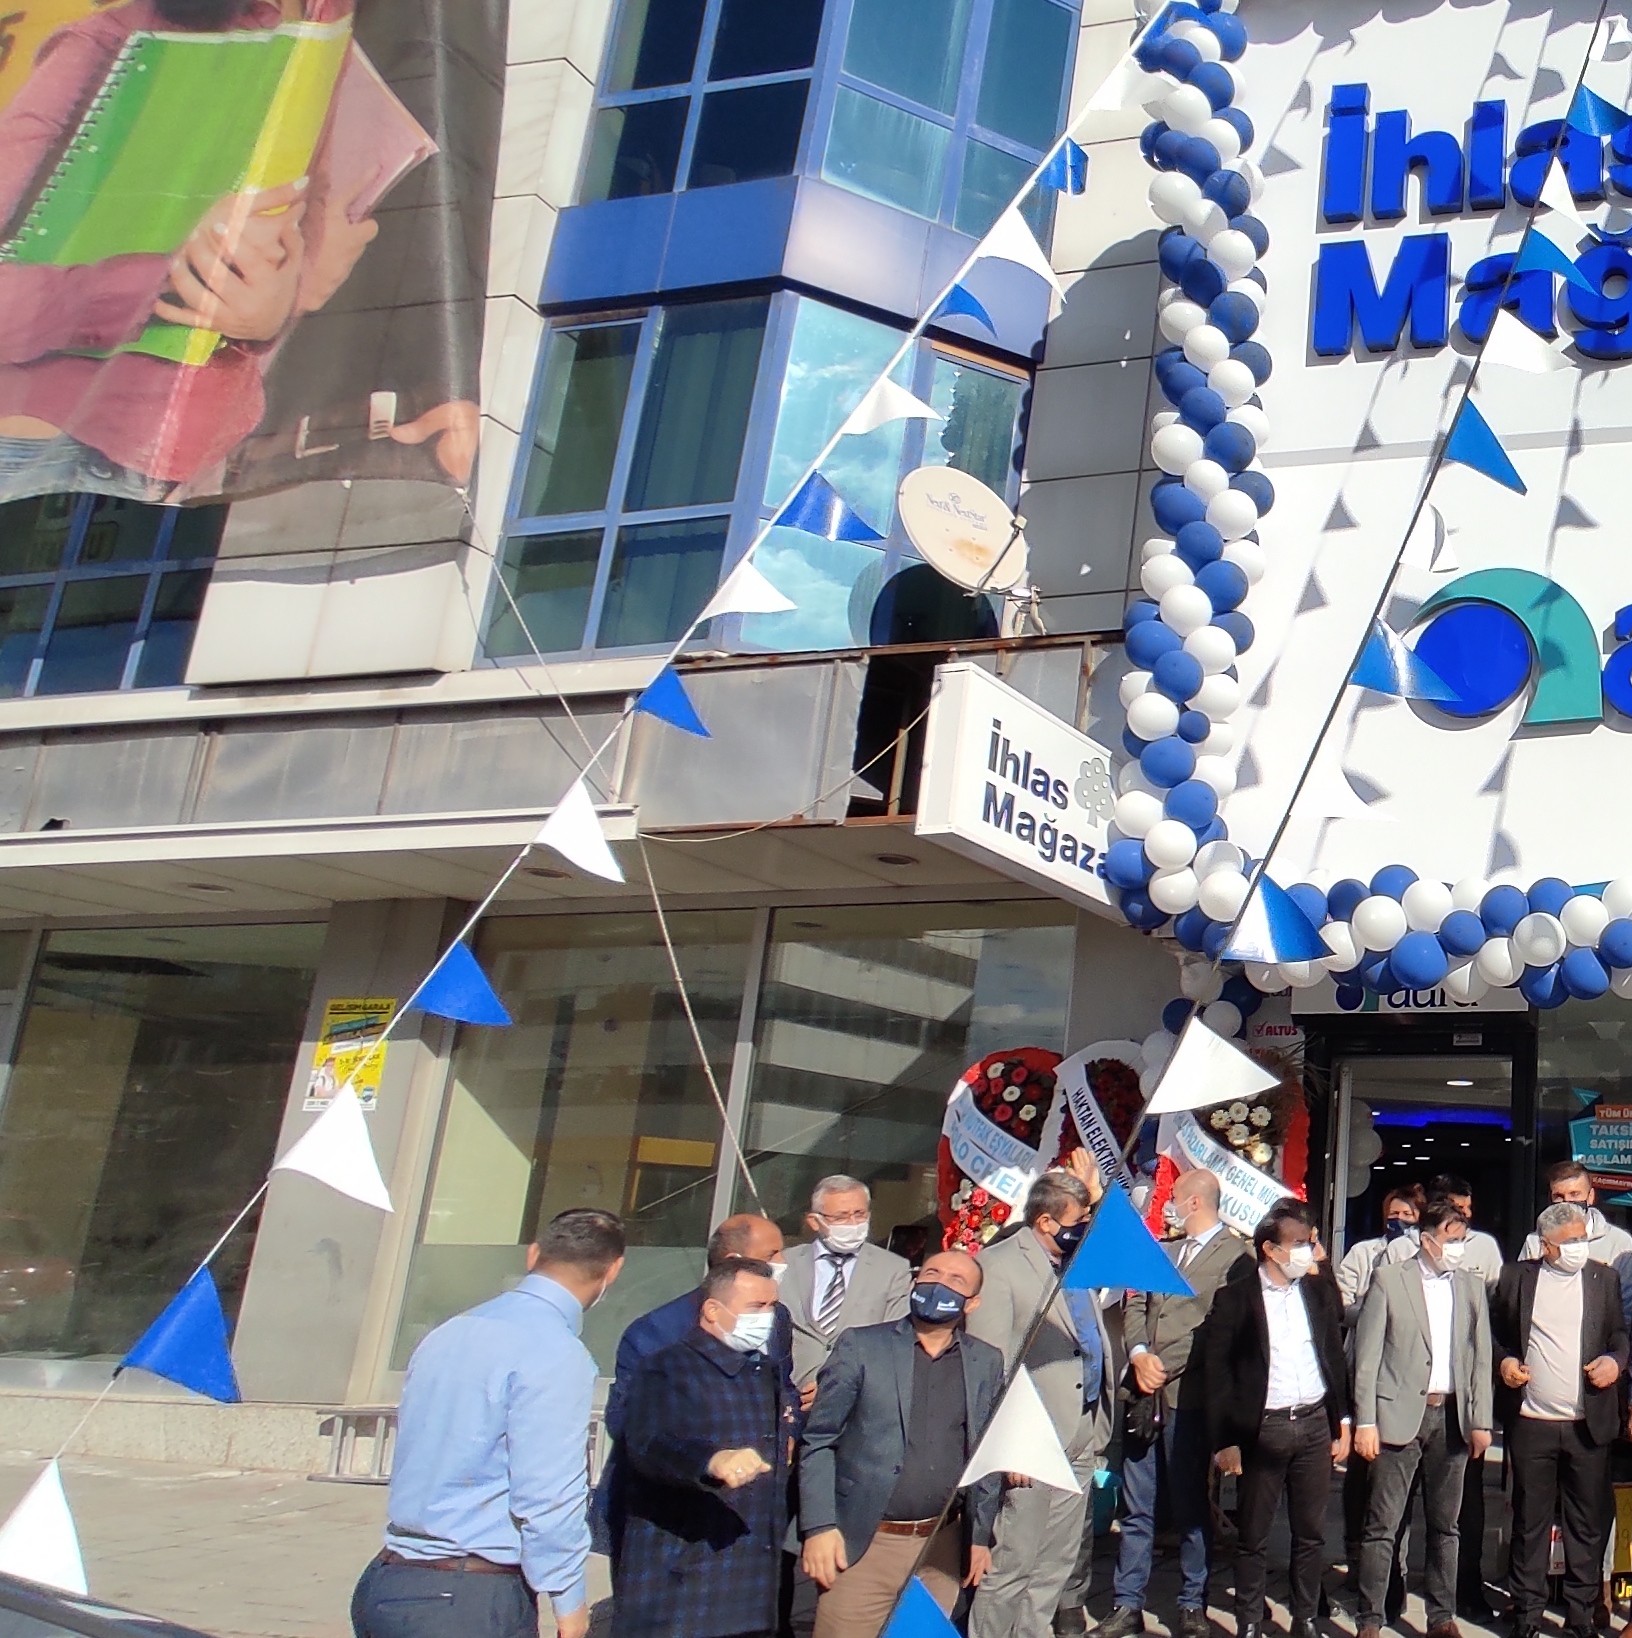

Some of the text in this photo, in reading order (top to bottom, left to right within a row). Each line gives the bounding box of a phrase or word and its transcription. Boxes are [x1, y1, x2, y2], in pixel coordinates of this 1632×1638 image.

[988, 717, 1069, 810] İhlas
[1265, 1025, 1298, 1036] ALTUS
[1071, 1087, 1096, 1132] HAKTAN
[1599, 1107, 1621, 1118] TÜM
